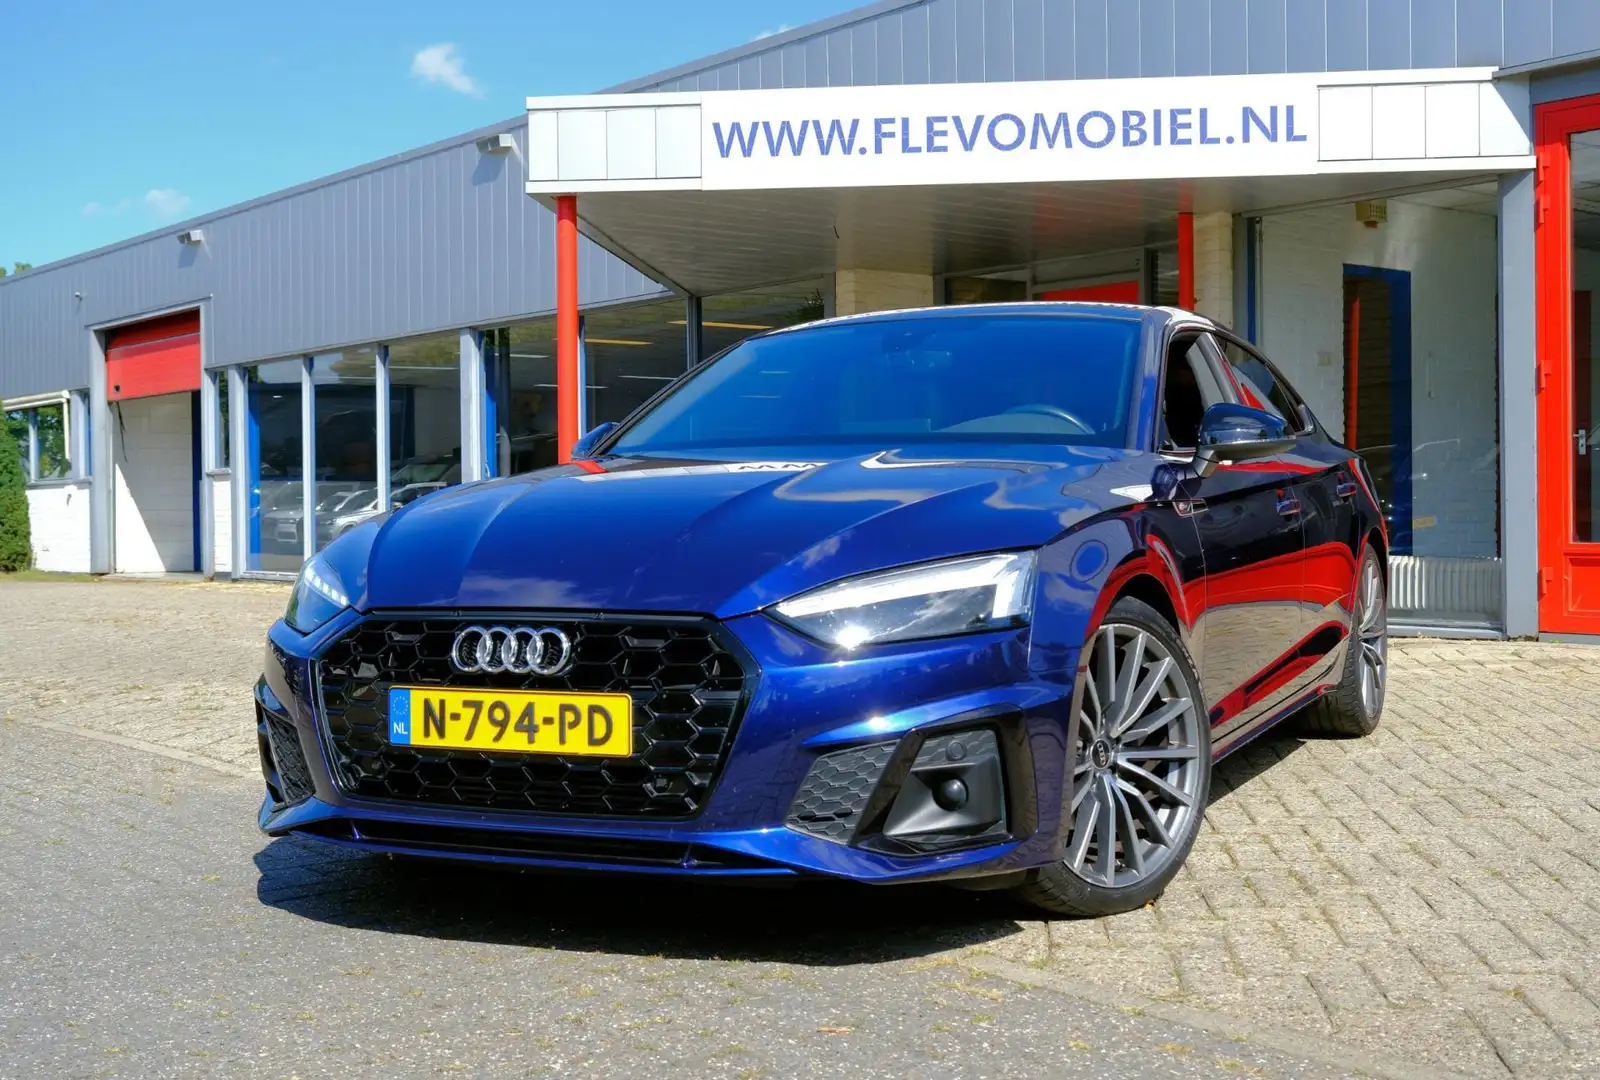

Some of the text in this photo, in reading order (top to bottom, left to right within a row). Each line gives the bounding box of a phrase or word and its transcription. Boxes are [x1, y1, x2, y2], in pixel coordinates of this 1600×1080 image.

[713, 105, 1307, 158] WWW.FLEVOMOBIEL.NL
[393, 722, 408, 735] NL
[423, 698, 613, 746] N-794-PD
